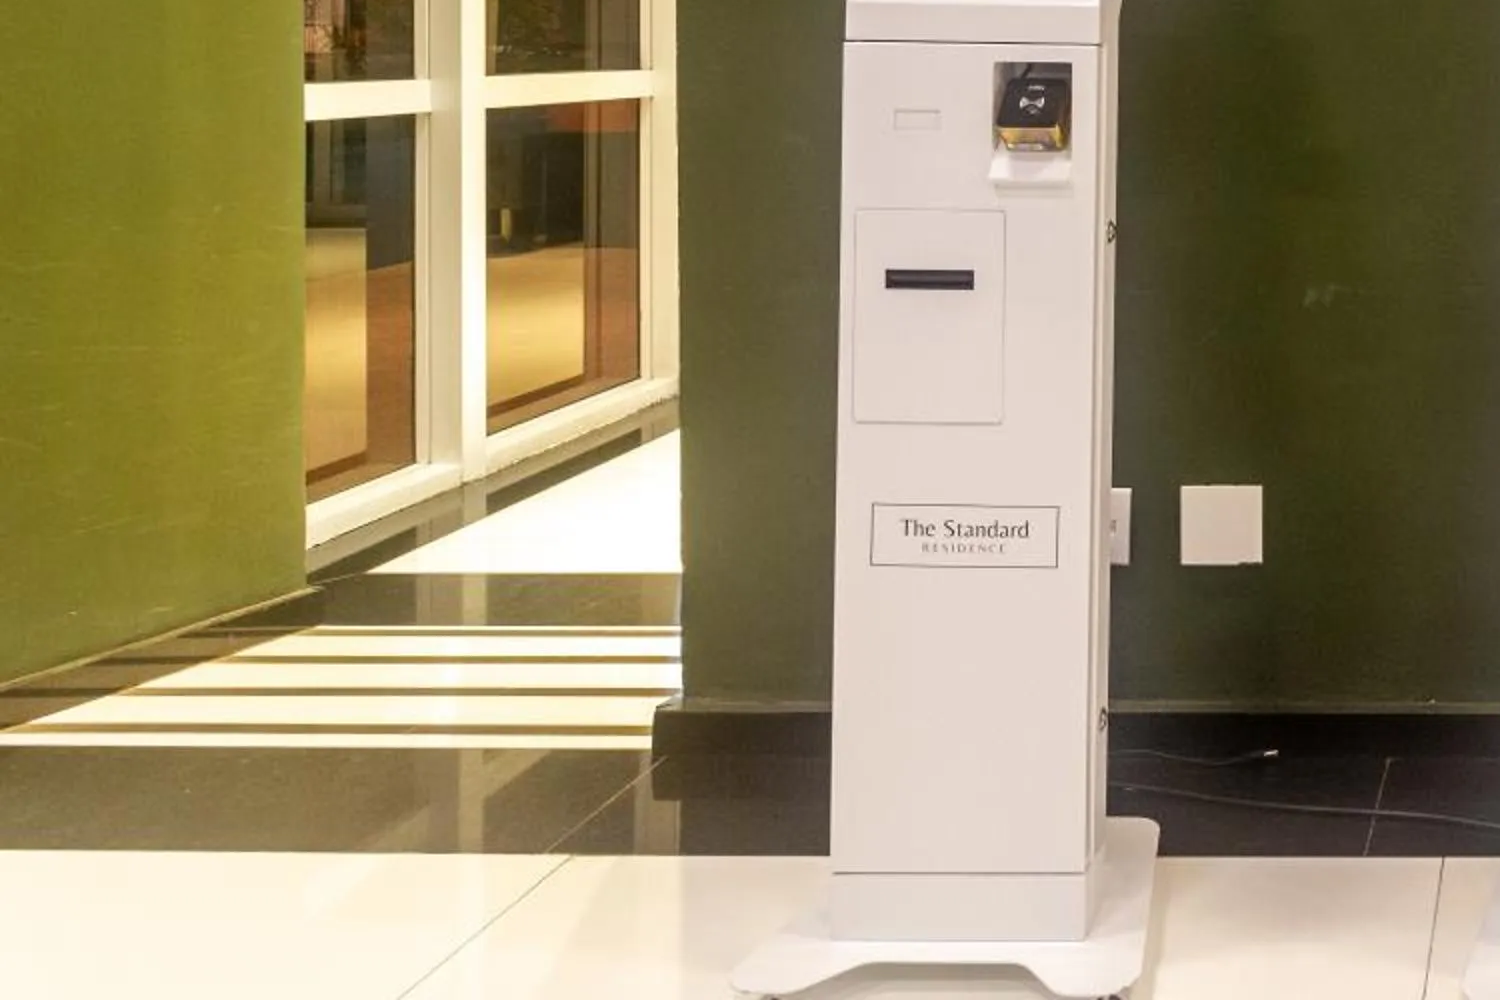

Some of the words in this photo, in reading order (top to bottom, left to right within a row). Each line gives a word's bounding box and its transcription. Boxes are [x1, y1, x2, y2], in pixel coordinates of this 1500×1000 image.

[900, 519, 936, 538] The
[944, 519, 1030, 539] Standard
[921, 543, 1006, 554] RESIDENCE
